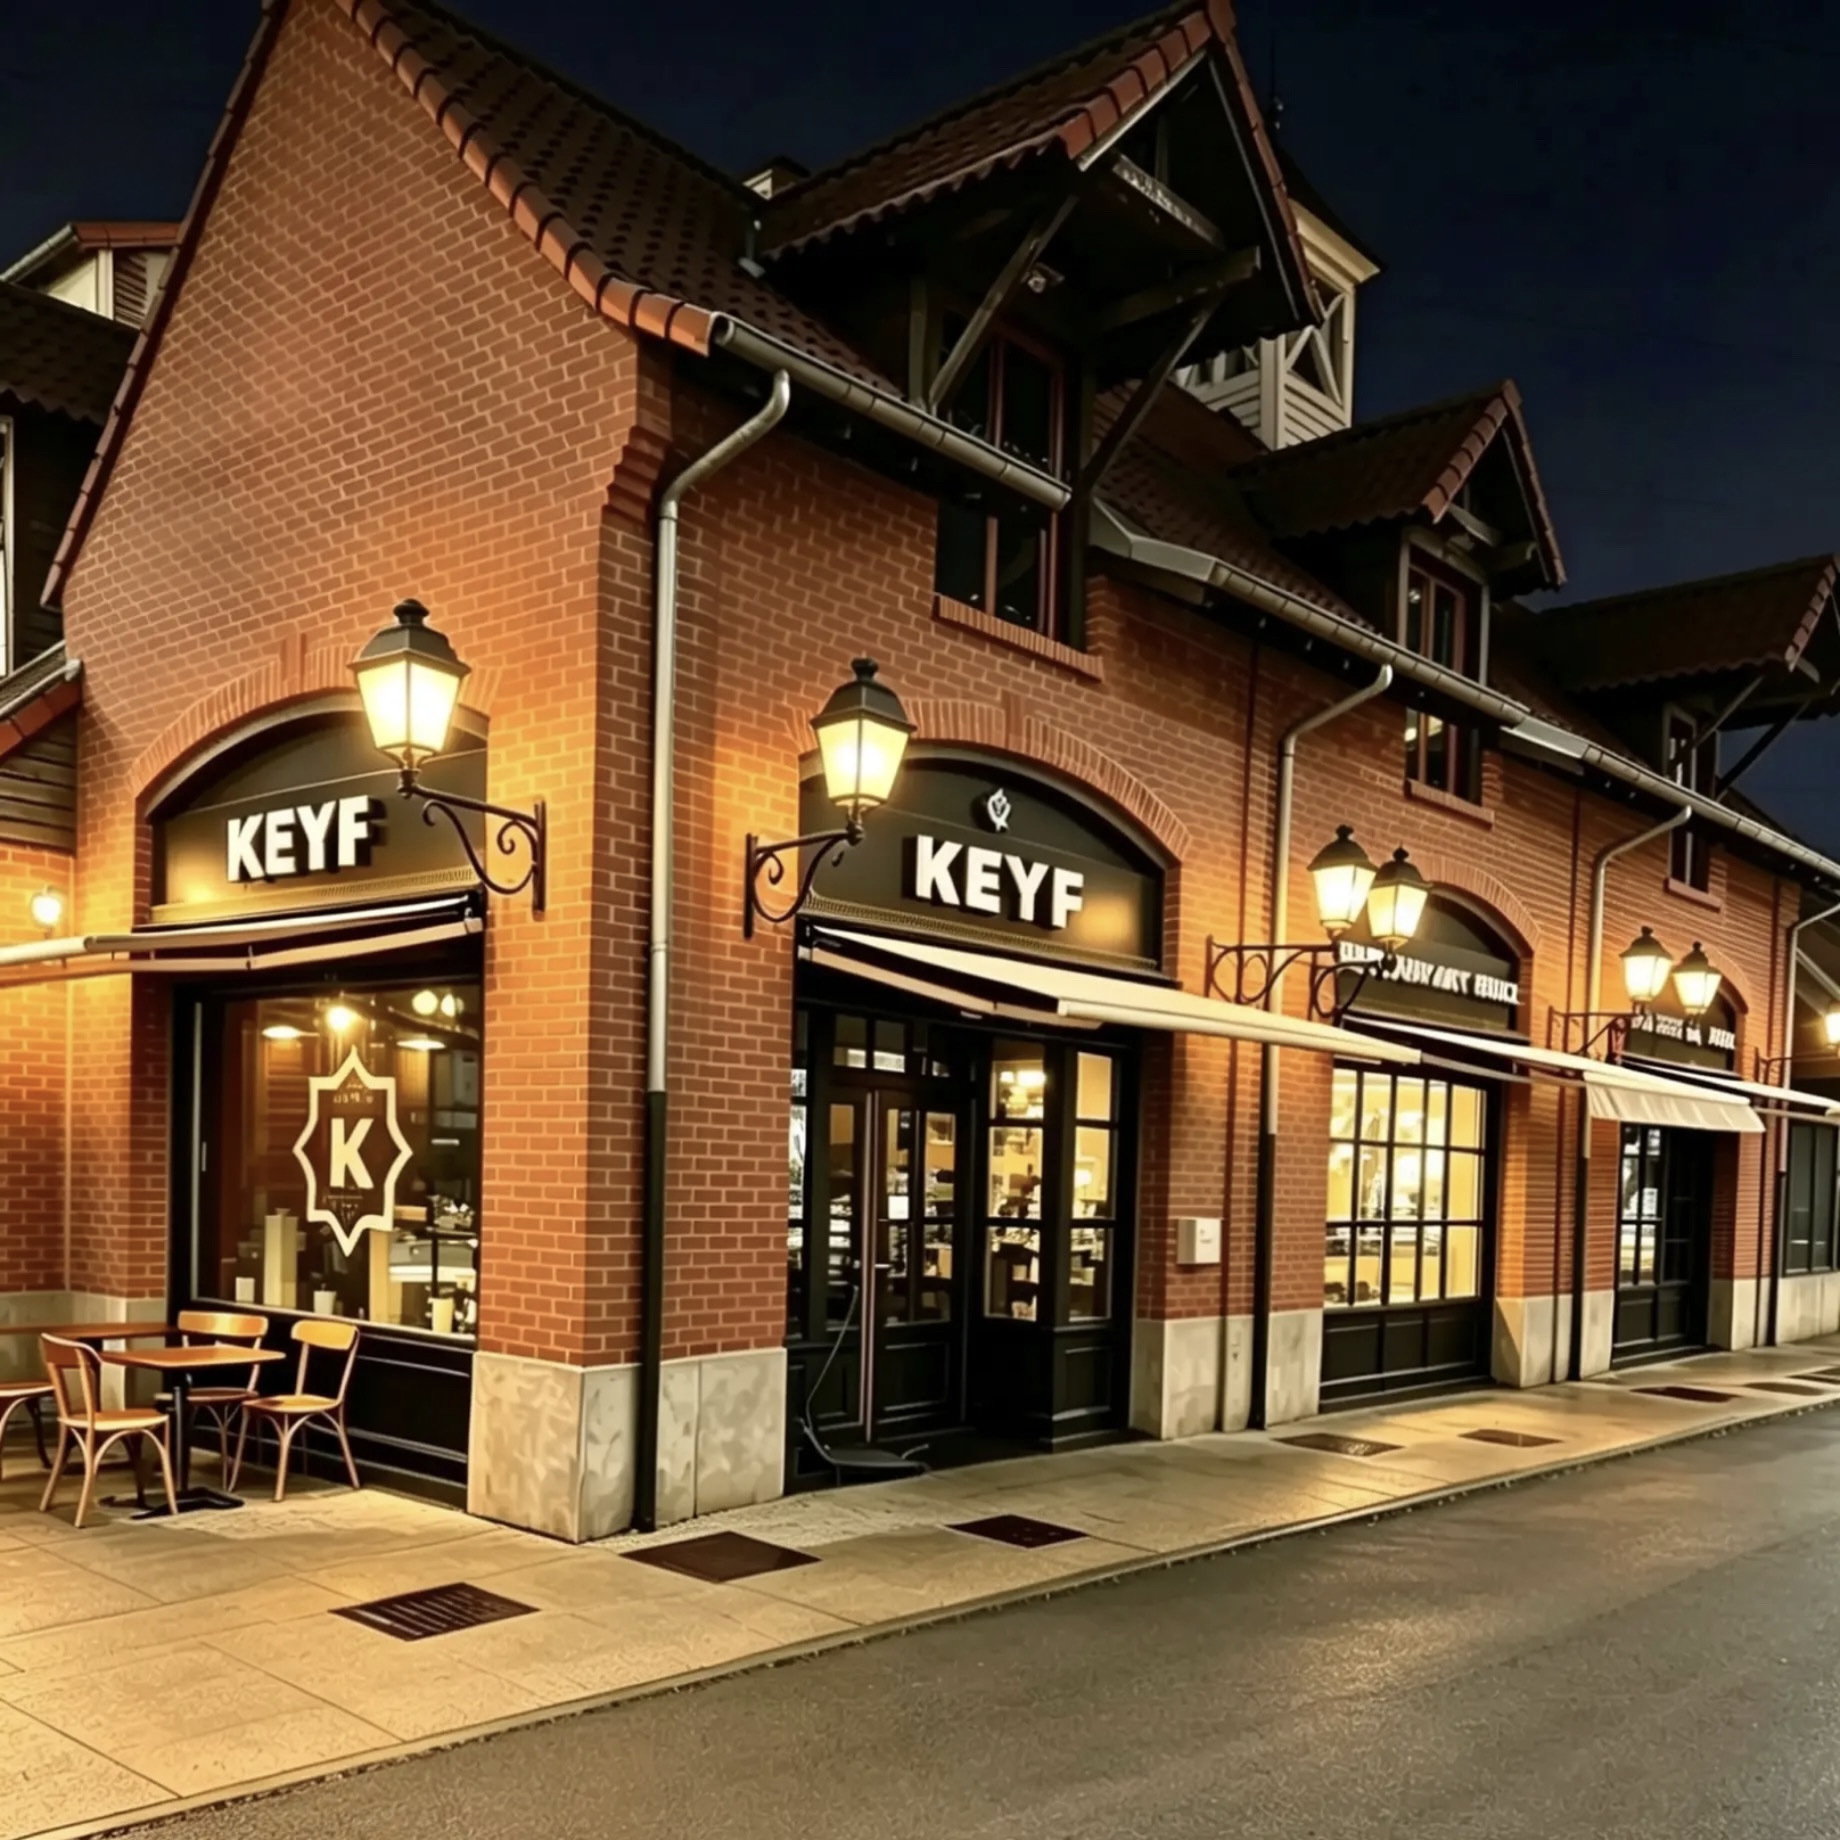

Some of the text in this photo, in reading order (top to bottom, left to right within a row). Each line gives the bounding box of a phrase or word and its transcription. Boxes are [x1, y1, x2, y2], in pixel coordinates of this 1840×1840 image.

[227, 795, 371, 882] KEYF
[916, 834, 1085, 929] KEYF
[330, 1117, 374, 1189] K
